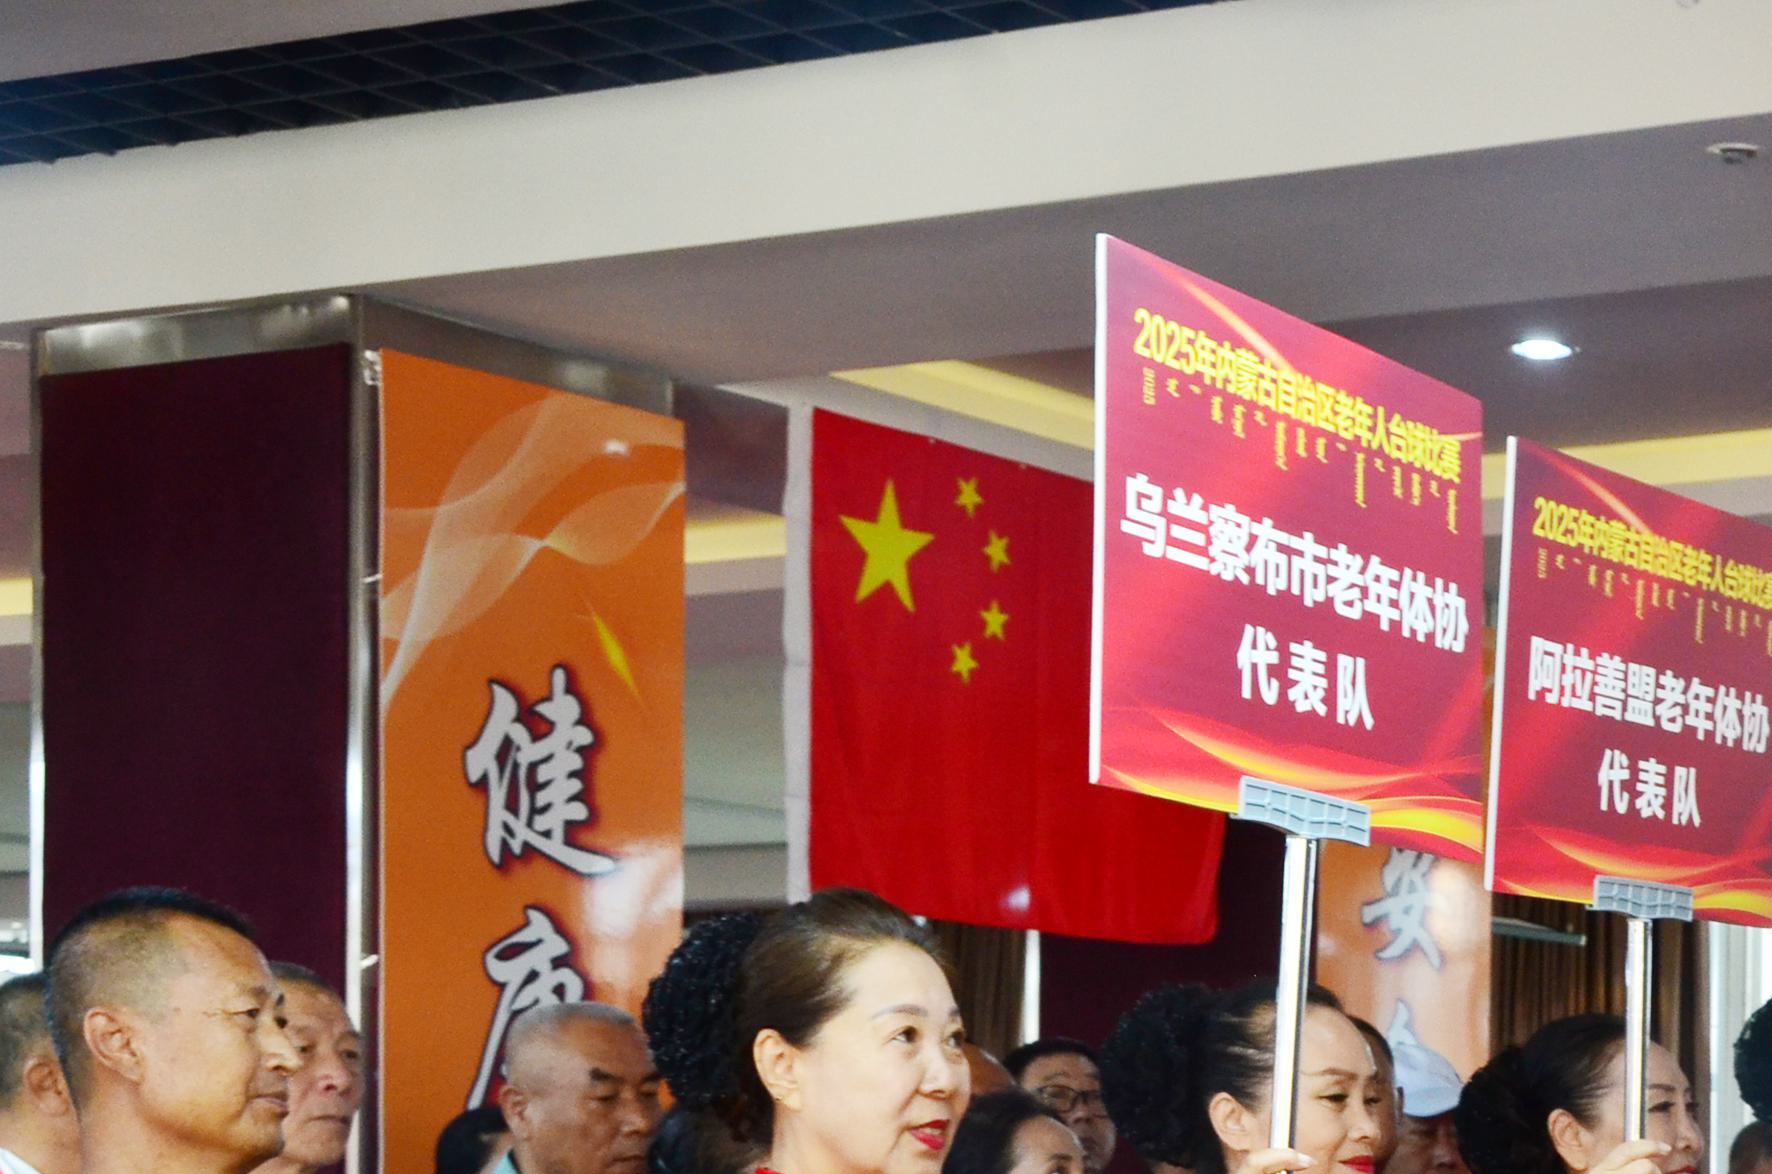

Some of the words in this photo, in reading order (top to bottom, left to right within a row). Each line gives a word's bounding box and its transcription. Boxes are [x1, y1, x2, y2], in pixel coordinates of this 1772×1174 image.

[1134, 308, 1461, 484] 2025年内蒙古自治区老年人台球比赛
[1121, 473, 1469, 652] 乌兰察布市老年体协
[1237, 623, 1374, 730] 代表队
[1528, 636, 1770, 753] 阿拉善盟老年体协
[1598, 748, 1702, 828] 代表队
